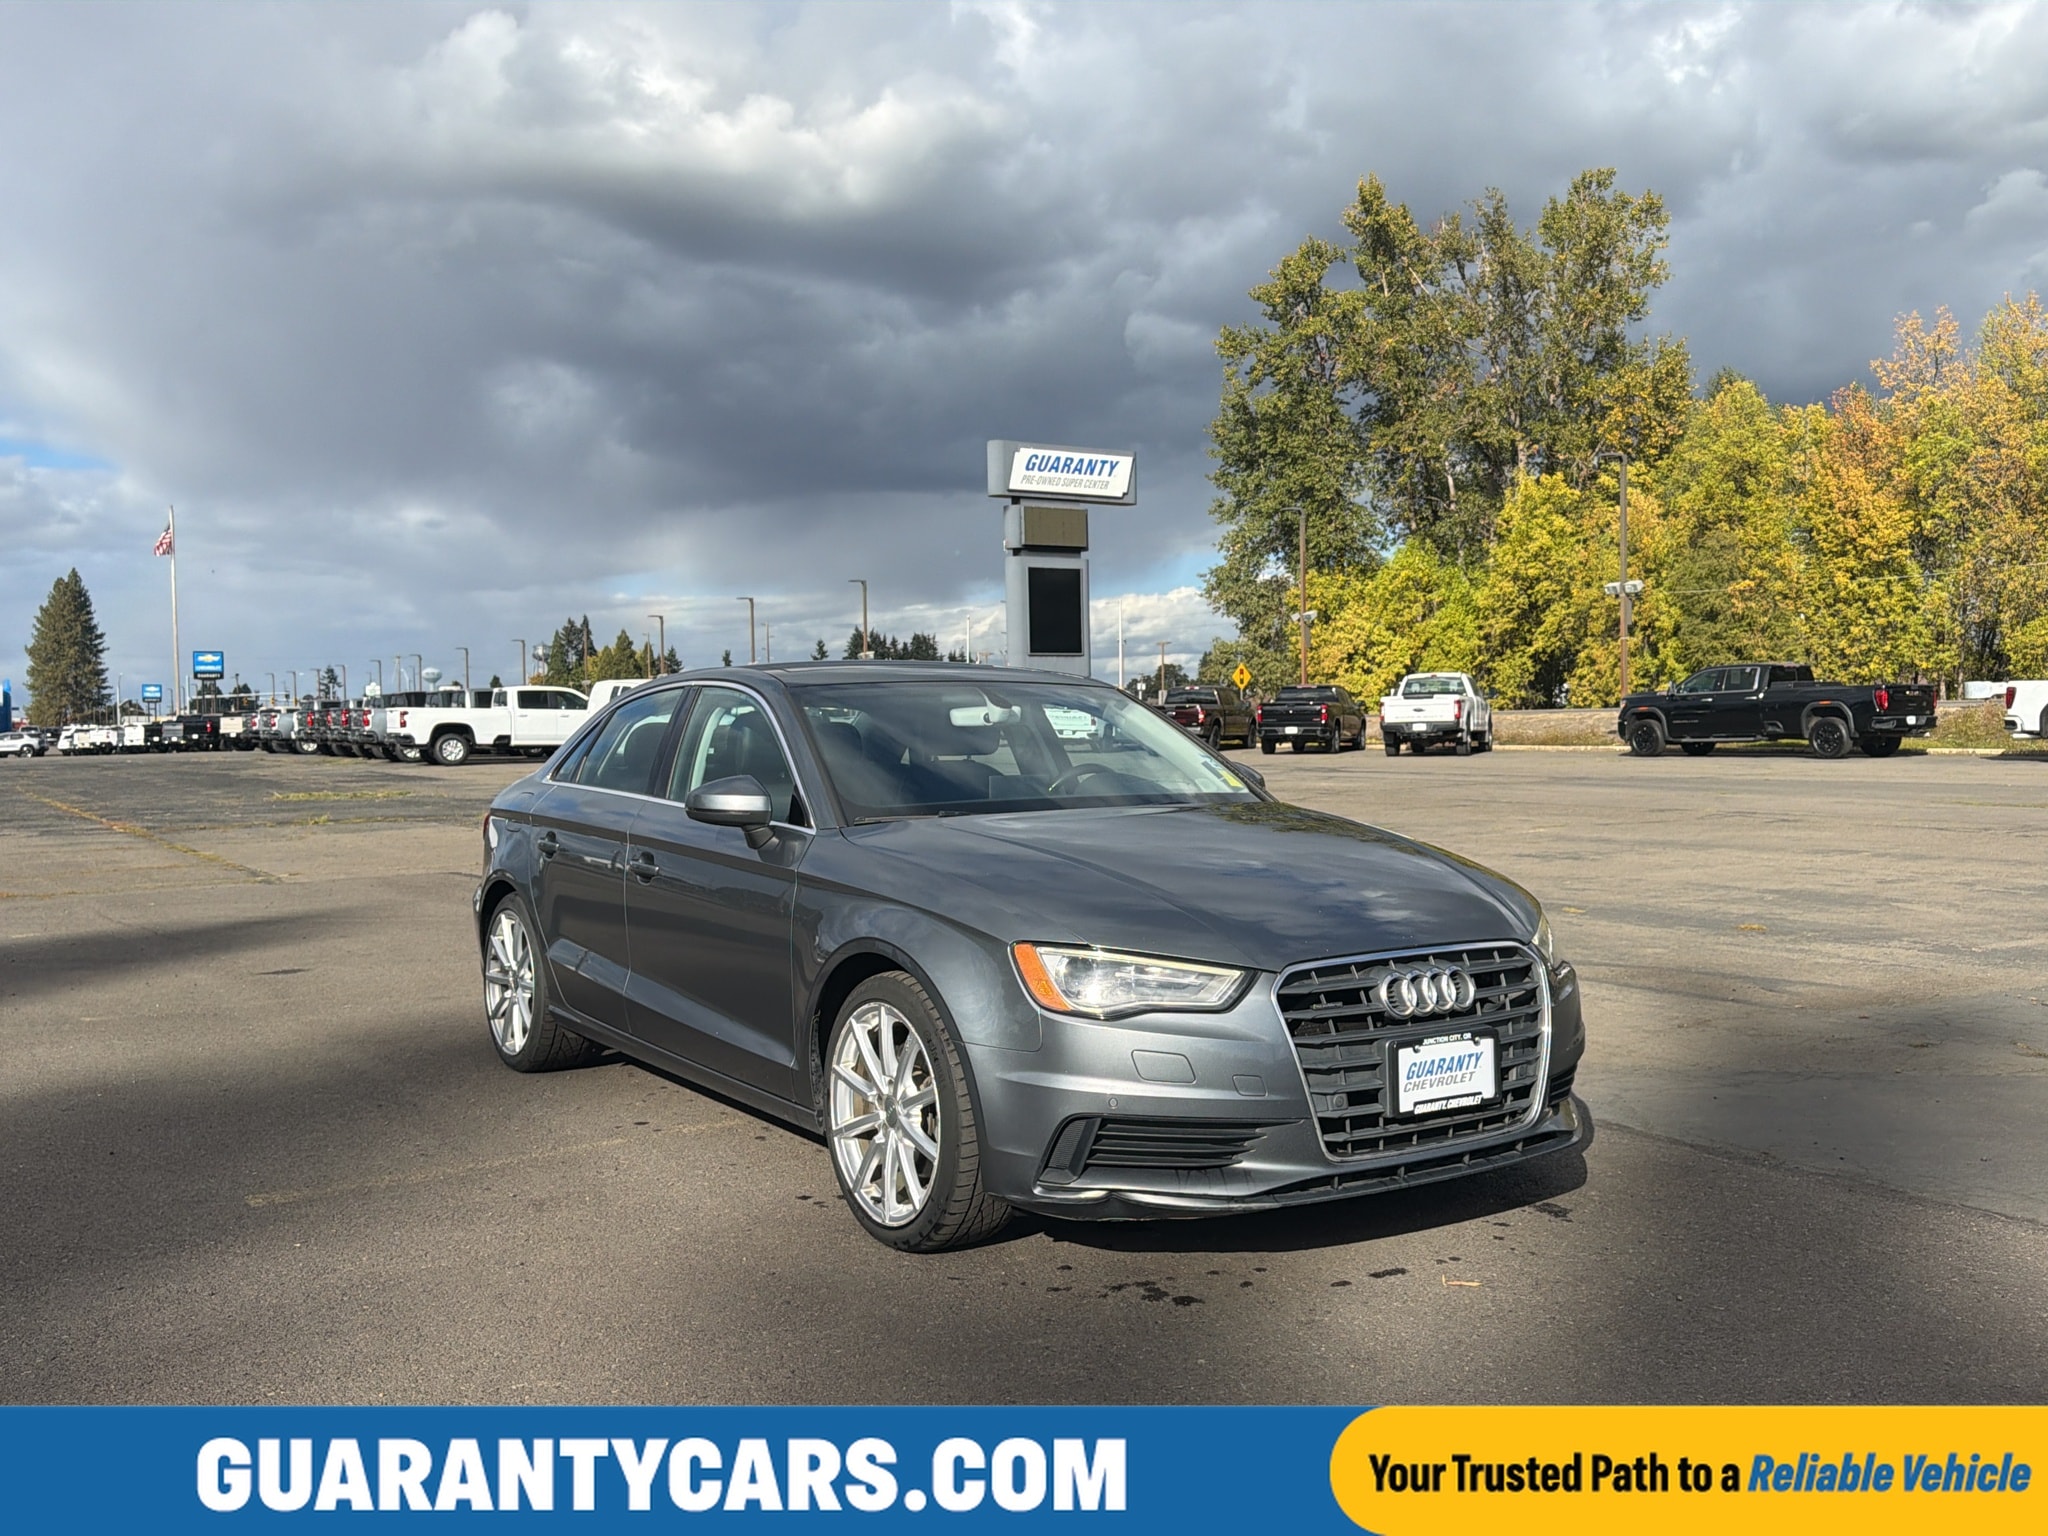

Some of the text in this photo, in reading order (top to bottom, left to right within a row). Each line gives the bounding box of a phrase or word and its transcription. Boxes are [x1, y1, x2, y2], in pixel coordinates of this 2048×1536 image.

[1025, 454, 1120, 477] GUARANTY
[1020, 475, 1110, 489] PRE-OWNED SUPER CENTER
[1406, 1051, 1484, 1081] GUARANTY
[1403, 1071, 1476, 1093] CHEVROLET
